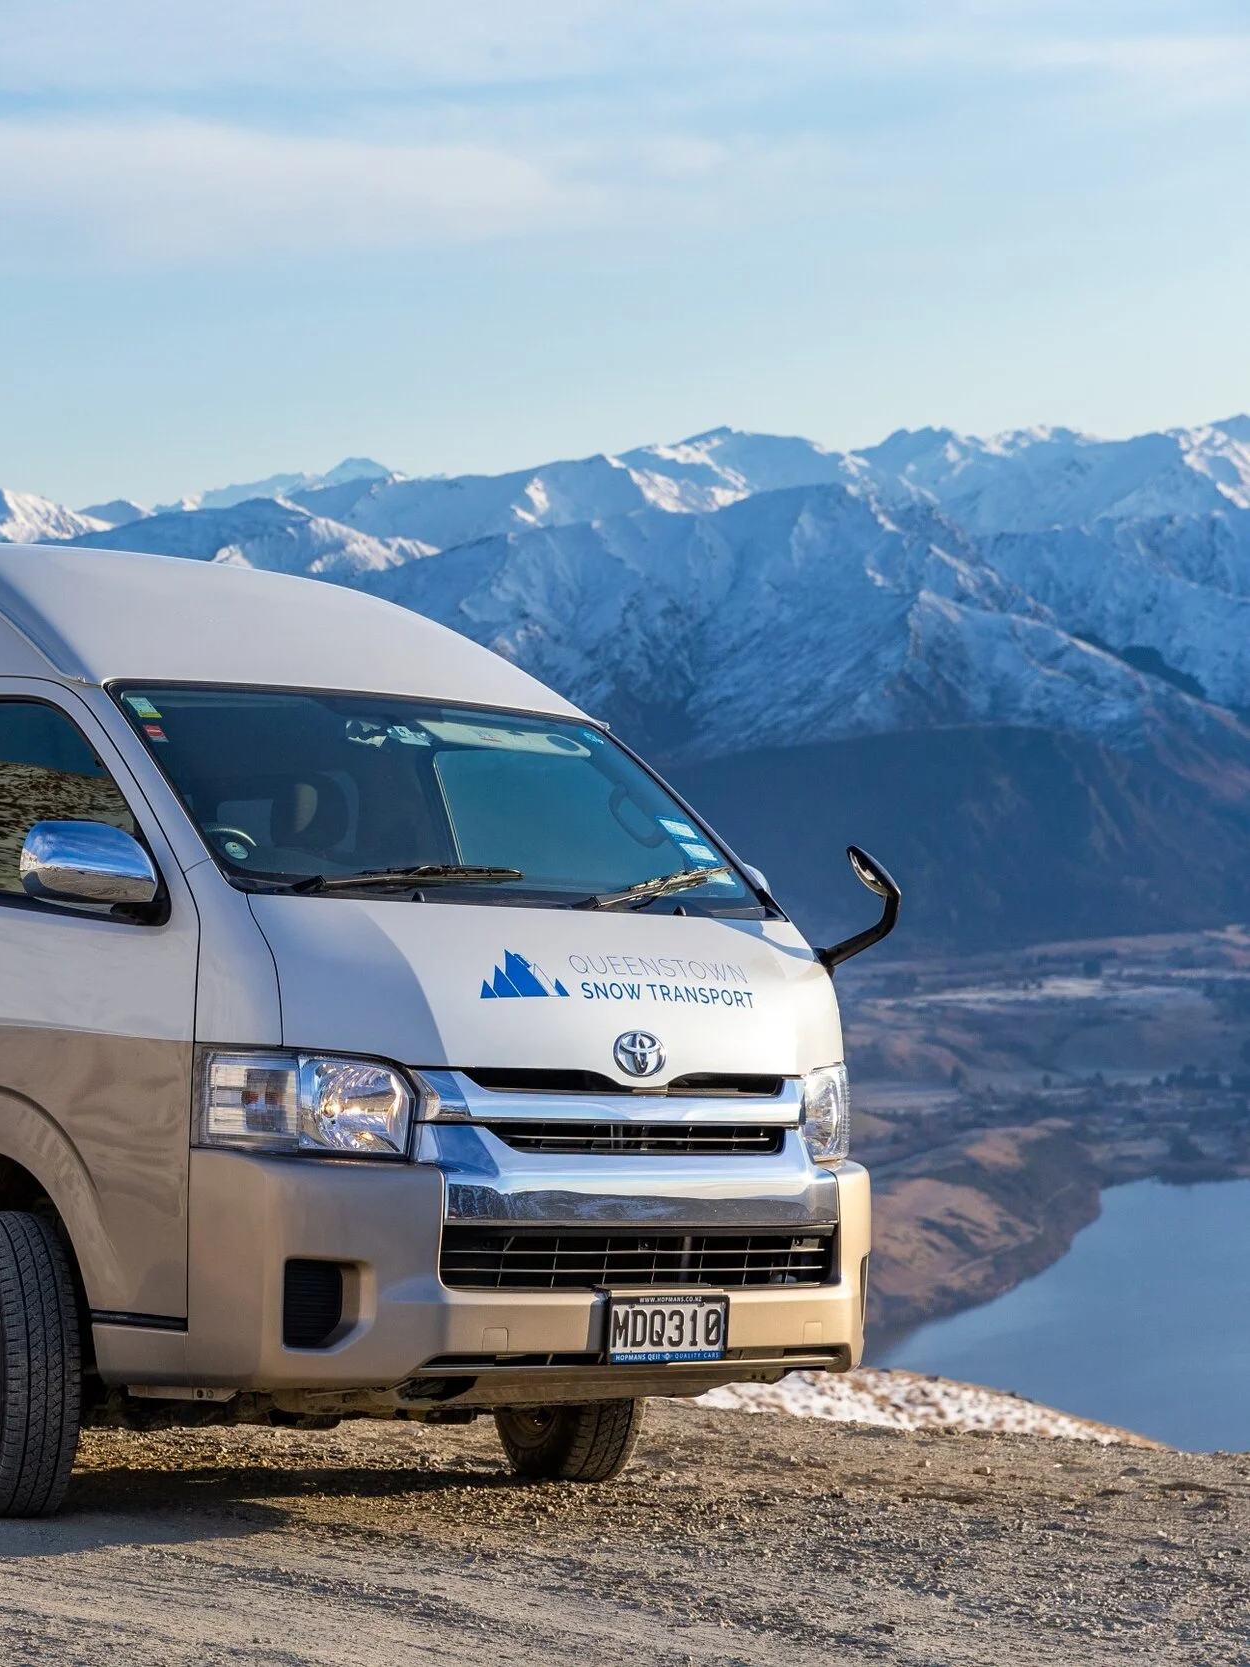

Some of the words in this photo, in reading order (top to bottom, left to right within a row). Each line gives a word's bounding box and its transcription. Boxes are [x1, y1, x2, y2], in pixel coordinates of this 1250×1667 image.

[568, 953, 749, 984] QUEENSTOWN
[581, 982, 641, 1000] SNOW
[646, 983, 753, 1009] TRANSPORT
[611, 1309, 722, 1347] MDQ310
[615, 1353, 646, 1361] HOPMANS
